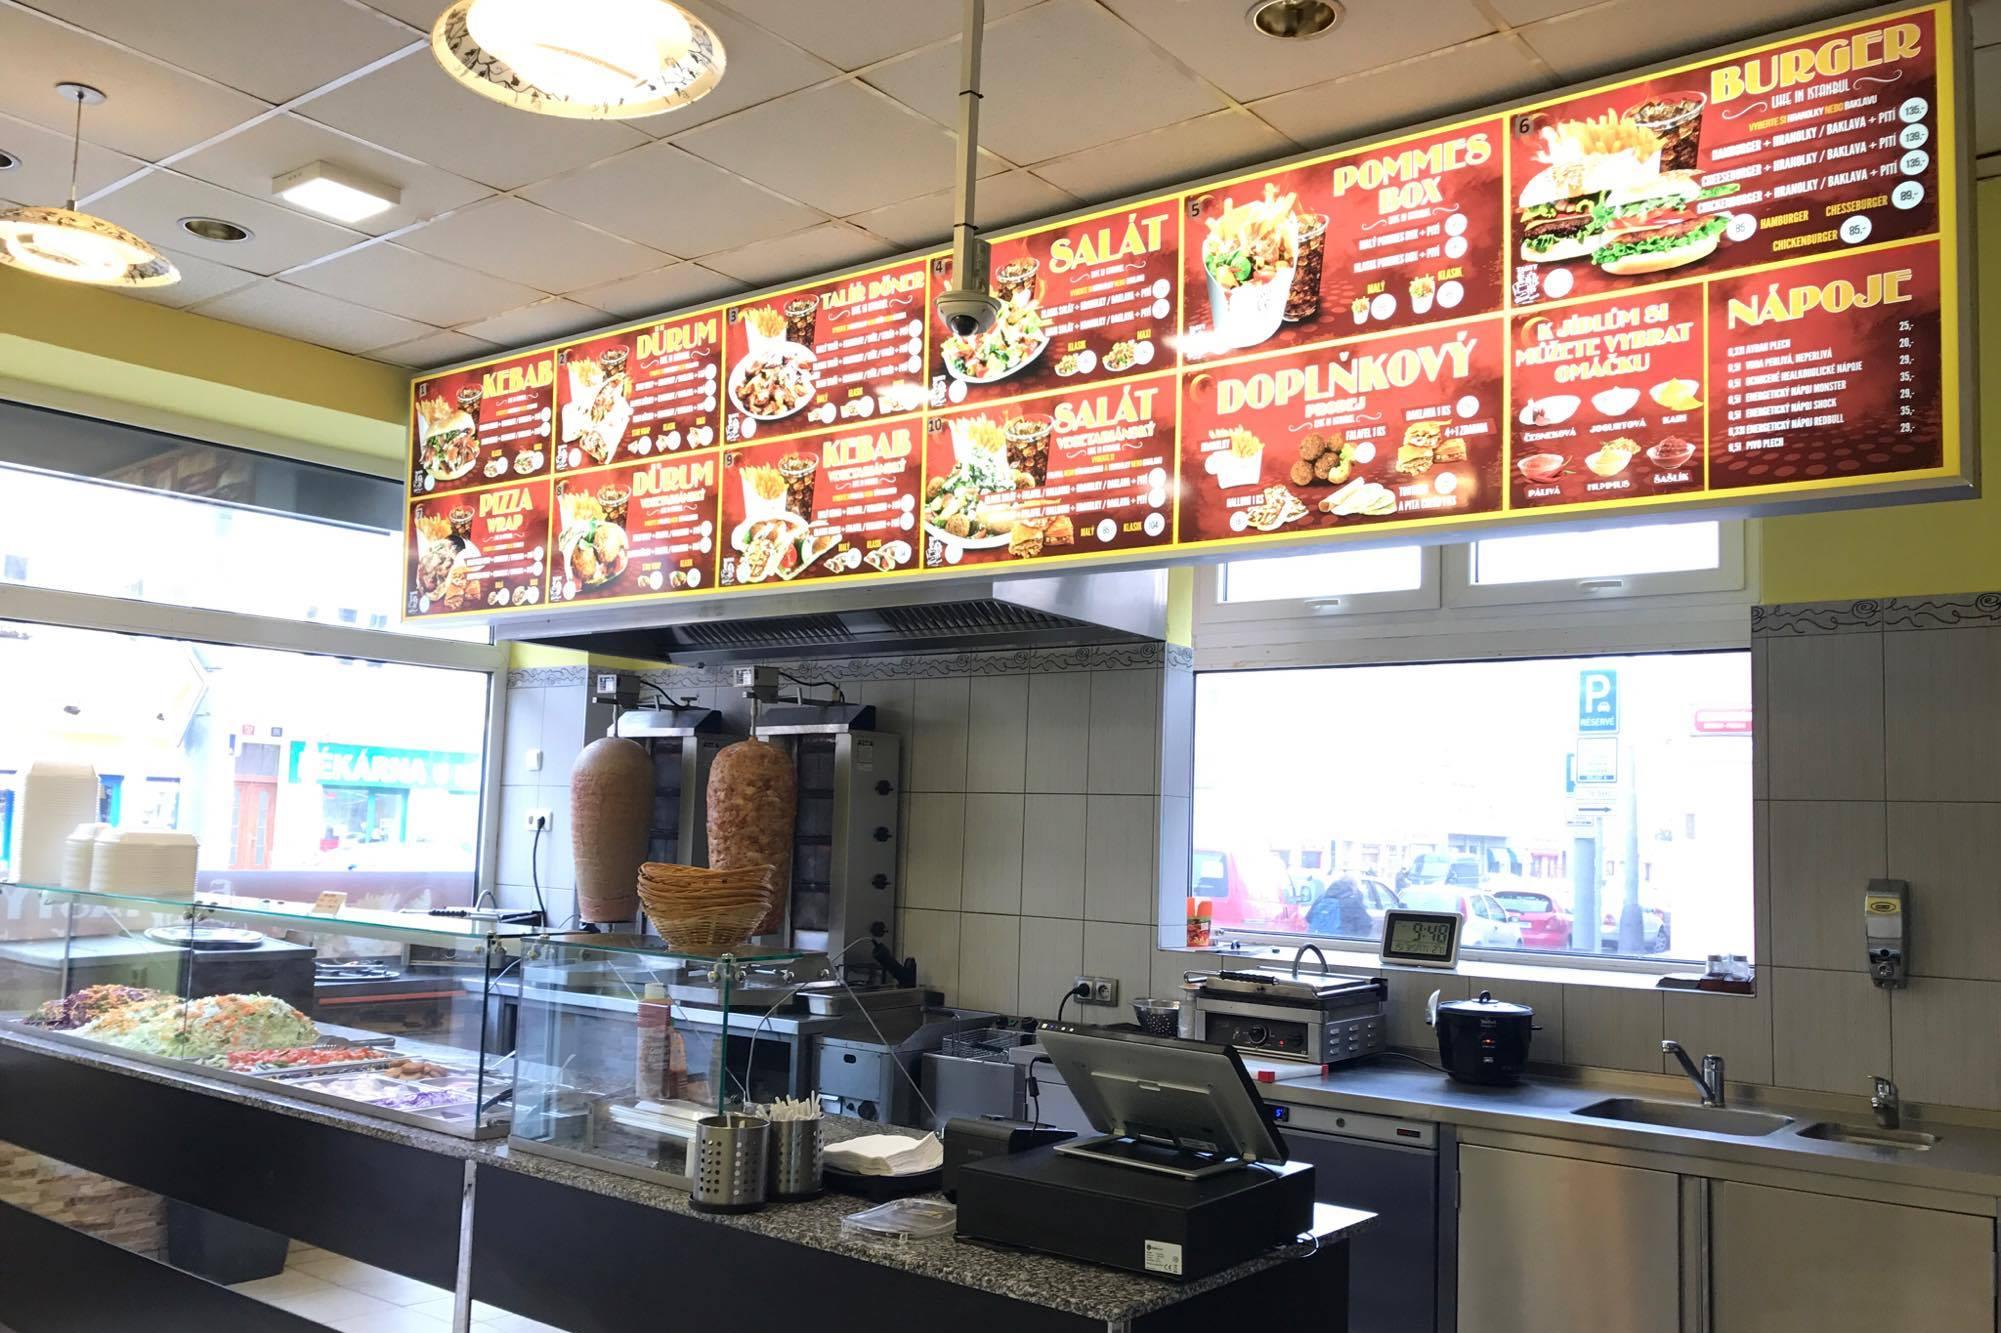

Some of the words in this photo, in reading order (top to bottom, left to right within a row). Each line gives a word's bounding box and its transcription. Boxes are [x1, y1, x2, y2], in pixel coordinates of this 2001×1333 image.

[1710, 23, 1922, 104] BURGER
[1795, 89, 1804, 103] IN
[1807, 79, 1851, 101] ISTANBUL
[1519, 118, 1530, 134] 6
[1826, 116, 1866, 135] BAKLAVA
[1878, 107, 1896, 124] PITÍ
[1827, 141, 1867, 160] BAKLAVA
[1879, 132, 1897, 149] PITÍ
[1333, 132, 1492, 197] POMMES
[1827, 168, 1868, 187] BAKLAVA
[1880, 160, 1897, 177] PITÍ
[1378, 176, 1443, 215] BOX
[1191, 202, 1200, 218] 5
[1760, 210, 1809, 230] HAMBURGER
[1049, 213, 1169, 274] SALÁT
[1772, 230, 1838, 252] CHICKENBURGER
[935, 261, 943, 273] 4
[1728, 268, 1913, 330] NÁPOJE
[729, 311, 737, 323] 3
[636, 318, 717, 360] DÜRUM
[559, 353, 566, 365] 2
[1836, 361, 1863, 374] NÁPOJE
[481, 360, 554, 399] KEBAB
[1217, 330, 1478, 415] DOPLŇKOVÝ
[1813, 380, 1847, 393] MONSTER
[1054, 385, 1159, 434] SALÁT
[1813, 397, 1837, 410] SHOCK
[928, 418, 942, 432] 10
[1813, 413, 1845, 426] REDBULL
[726, 454, 733, 466] 9
[822, 428, 912, 469] KEBAB
[632, 461, 715, 496] DÜRUM
[479, 488, 534, 518] PIZZA
[487, 514, 523, 534] WRAP
[1413, 922, 1449, 943] 9:48
